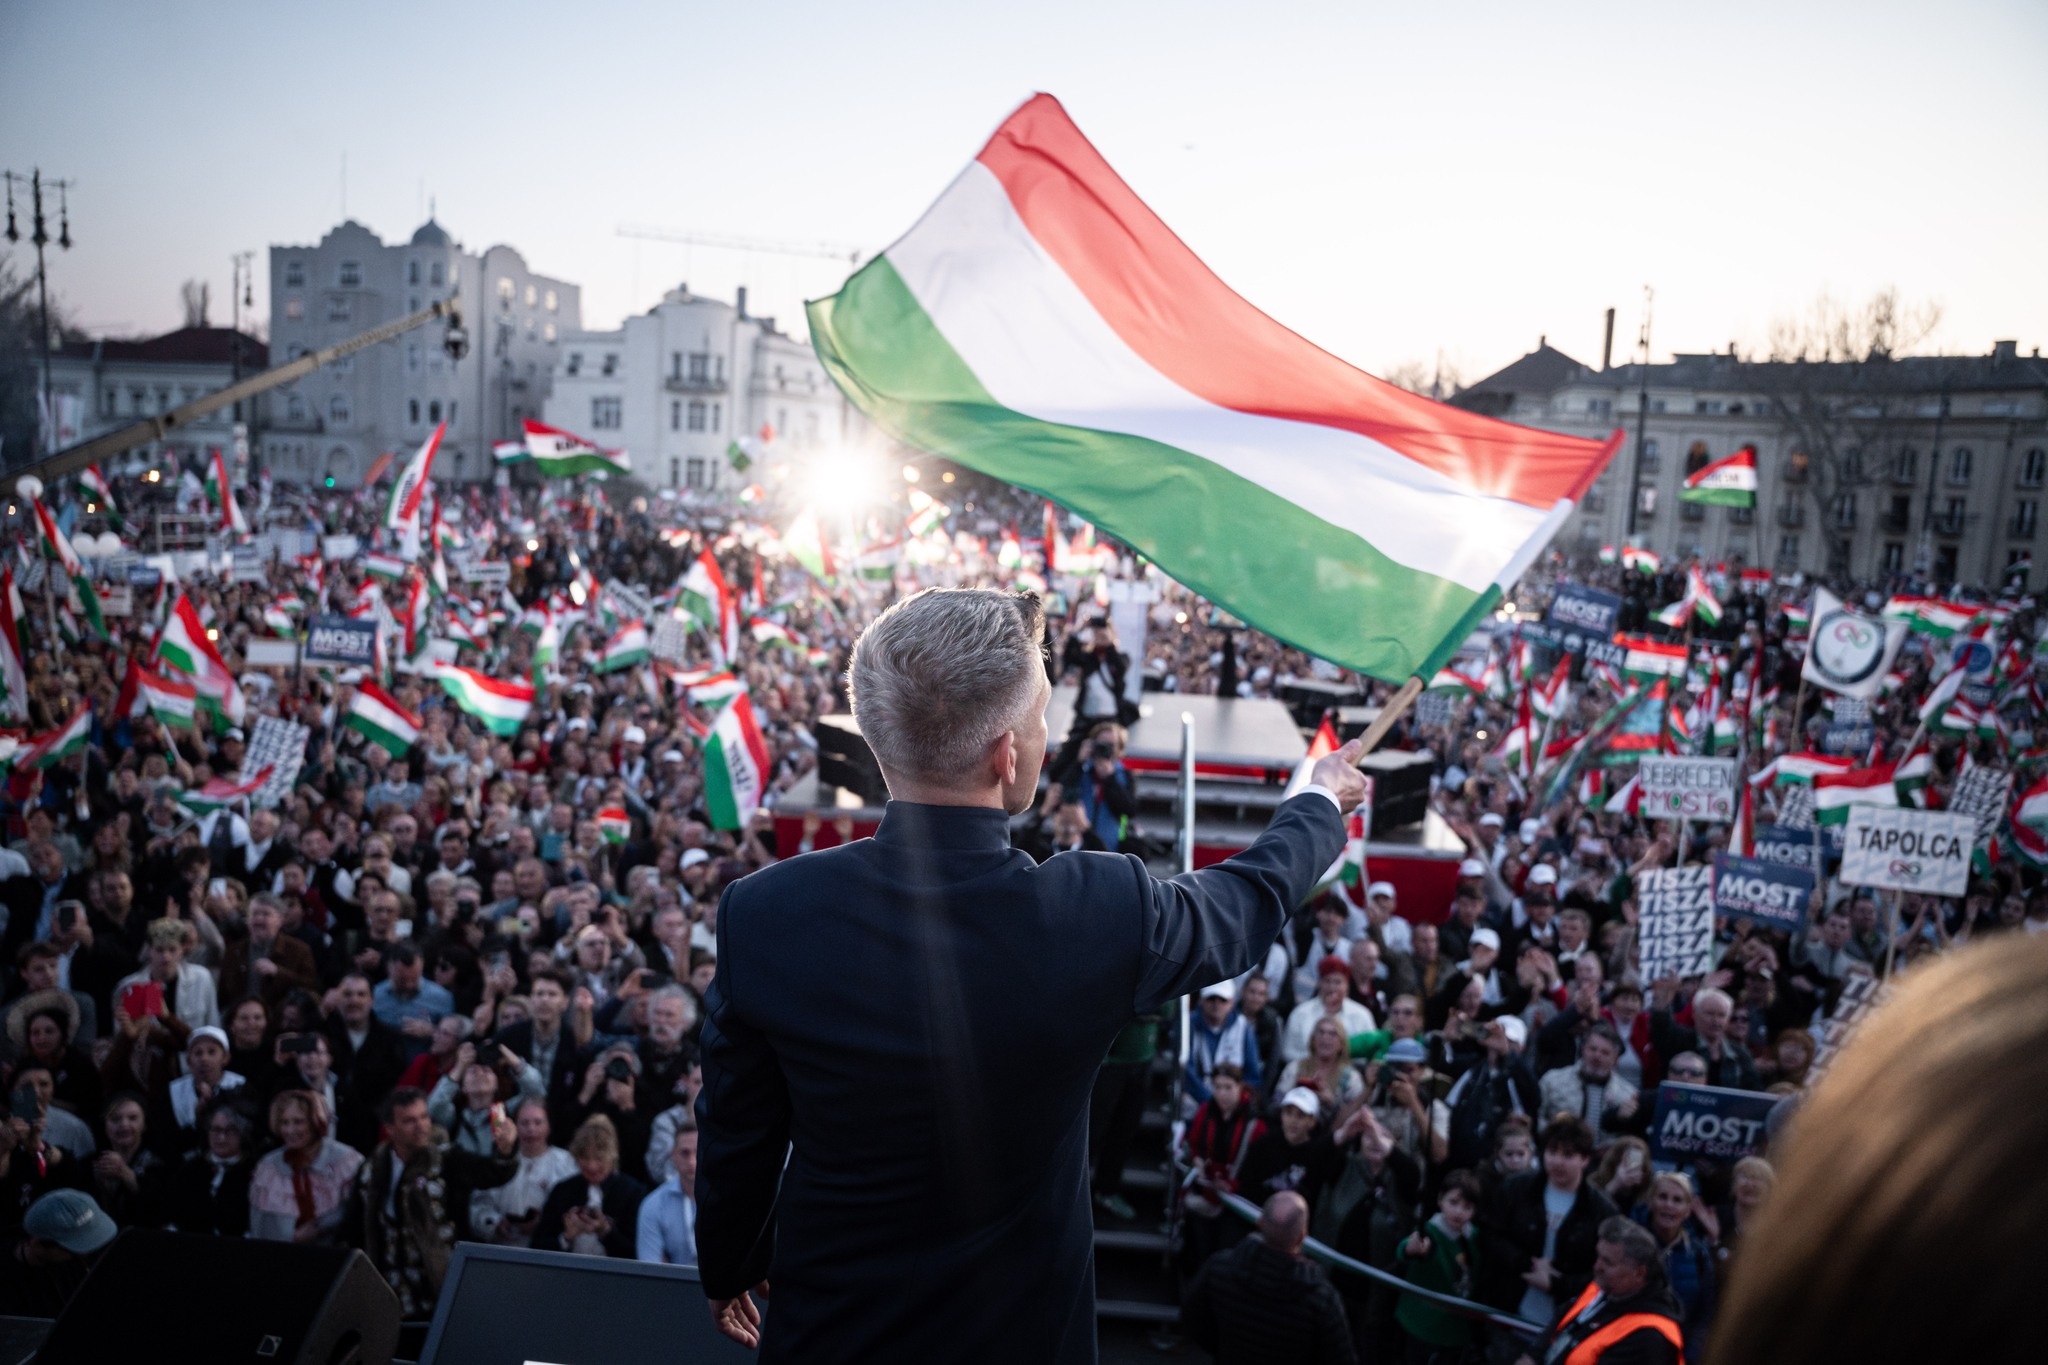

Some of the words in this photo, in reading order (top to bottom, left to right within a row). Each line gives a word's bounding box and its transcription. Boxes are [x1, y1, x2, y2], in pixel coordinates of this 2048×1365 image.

[1553, 594, 1612, 622] MOST
[311, 627, 373, 650] MOST
[1585, 638, 1624, 669] TATA
[1640, 763, 1733, 790] DEBRECEN
[1858, 826, 1961, 861] TAPOLCA
[1639, 866, 1713, 892] TISZA
[1717, 873, 1804, 910] MOST
[1639, 888, 1713, 914] TISZA
[1640, 910, 1713, 937] TISZA
[1640, 932, 1713, 959] TISZA
[1661, 1109, 1763, 1145] MOST
